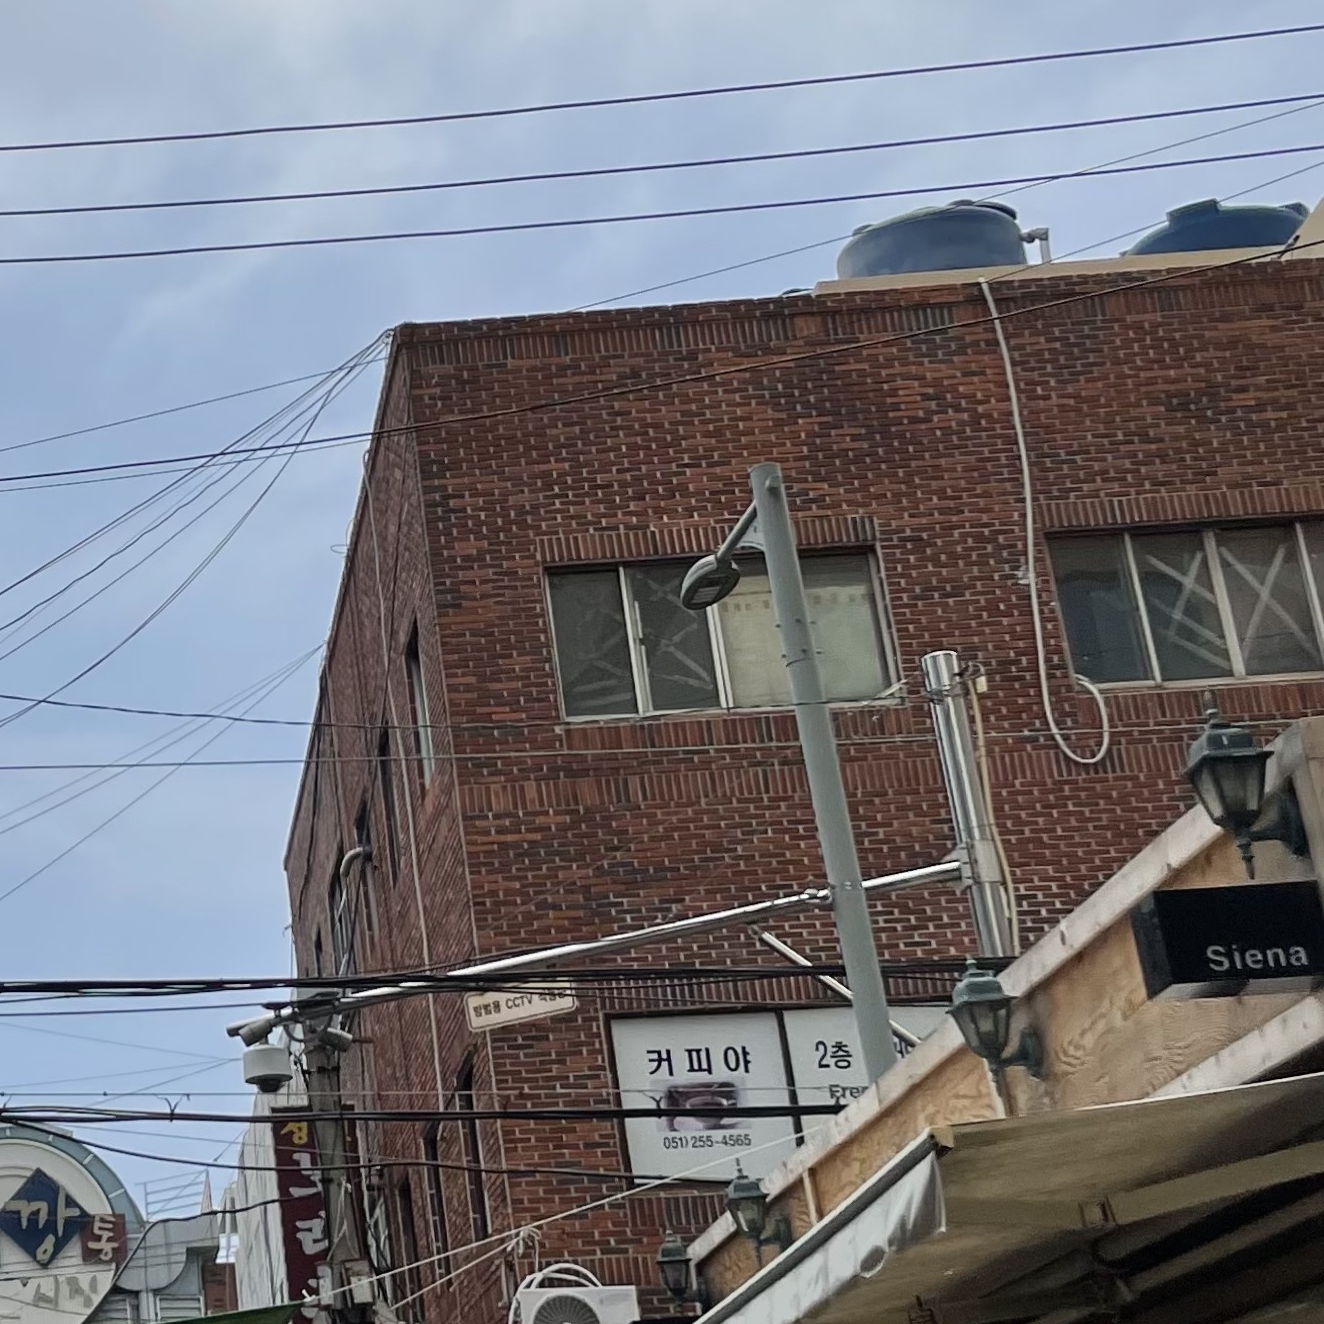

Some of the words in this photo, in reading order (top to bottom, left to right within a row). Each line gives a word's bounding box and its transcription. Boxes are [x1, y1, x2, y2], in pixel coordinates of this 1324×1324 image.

[1206, 944, 1309, 971] Siena
[505, 994, 533, 1009] CCTV
[814, 1041, 853, 1070] 2층
